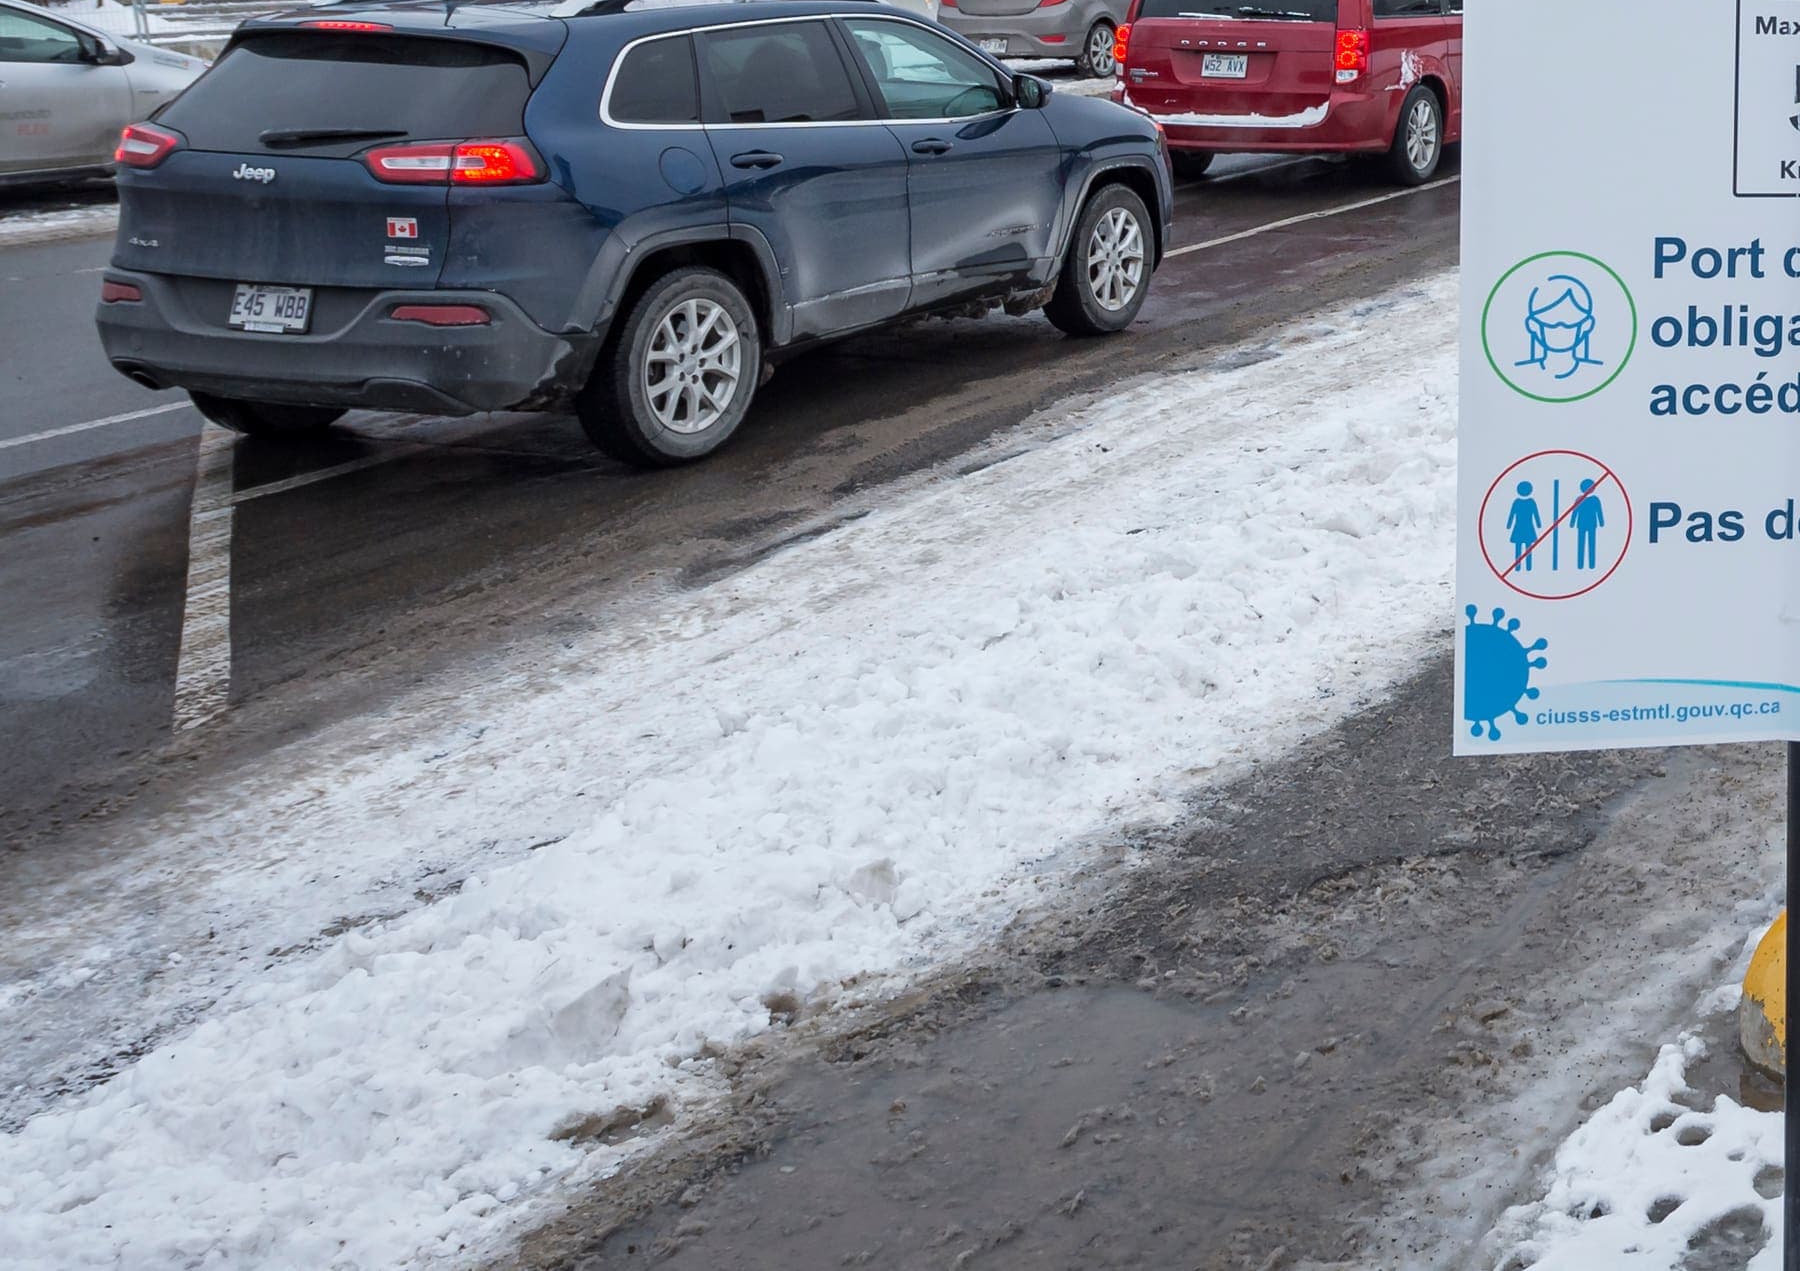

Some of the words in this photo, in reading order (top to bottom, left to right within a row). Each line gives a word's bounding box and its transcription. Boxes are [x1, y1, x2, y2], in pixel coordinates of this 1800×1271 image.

[1227, 59, 1245, 73] AVX
[232, 163, 276, 184] Jeep
[1652, 236, 1765, 280] Port
[232, 292, 267, 316] E45
[273, 294, 307, 319] WBB
[1648, 501, 1746, 544] Pas
[1536, 700, 1781, 726] ciusss-estmtl.gouv.qc.ca
